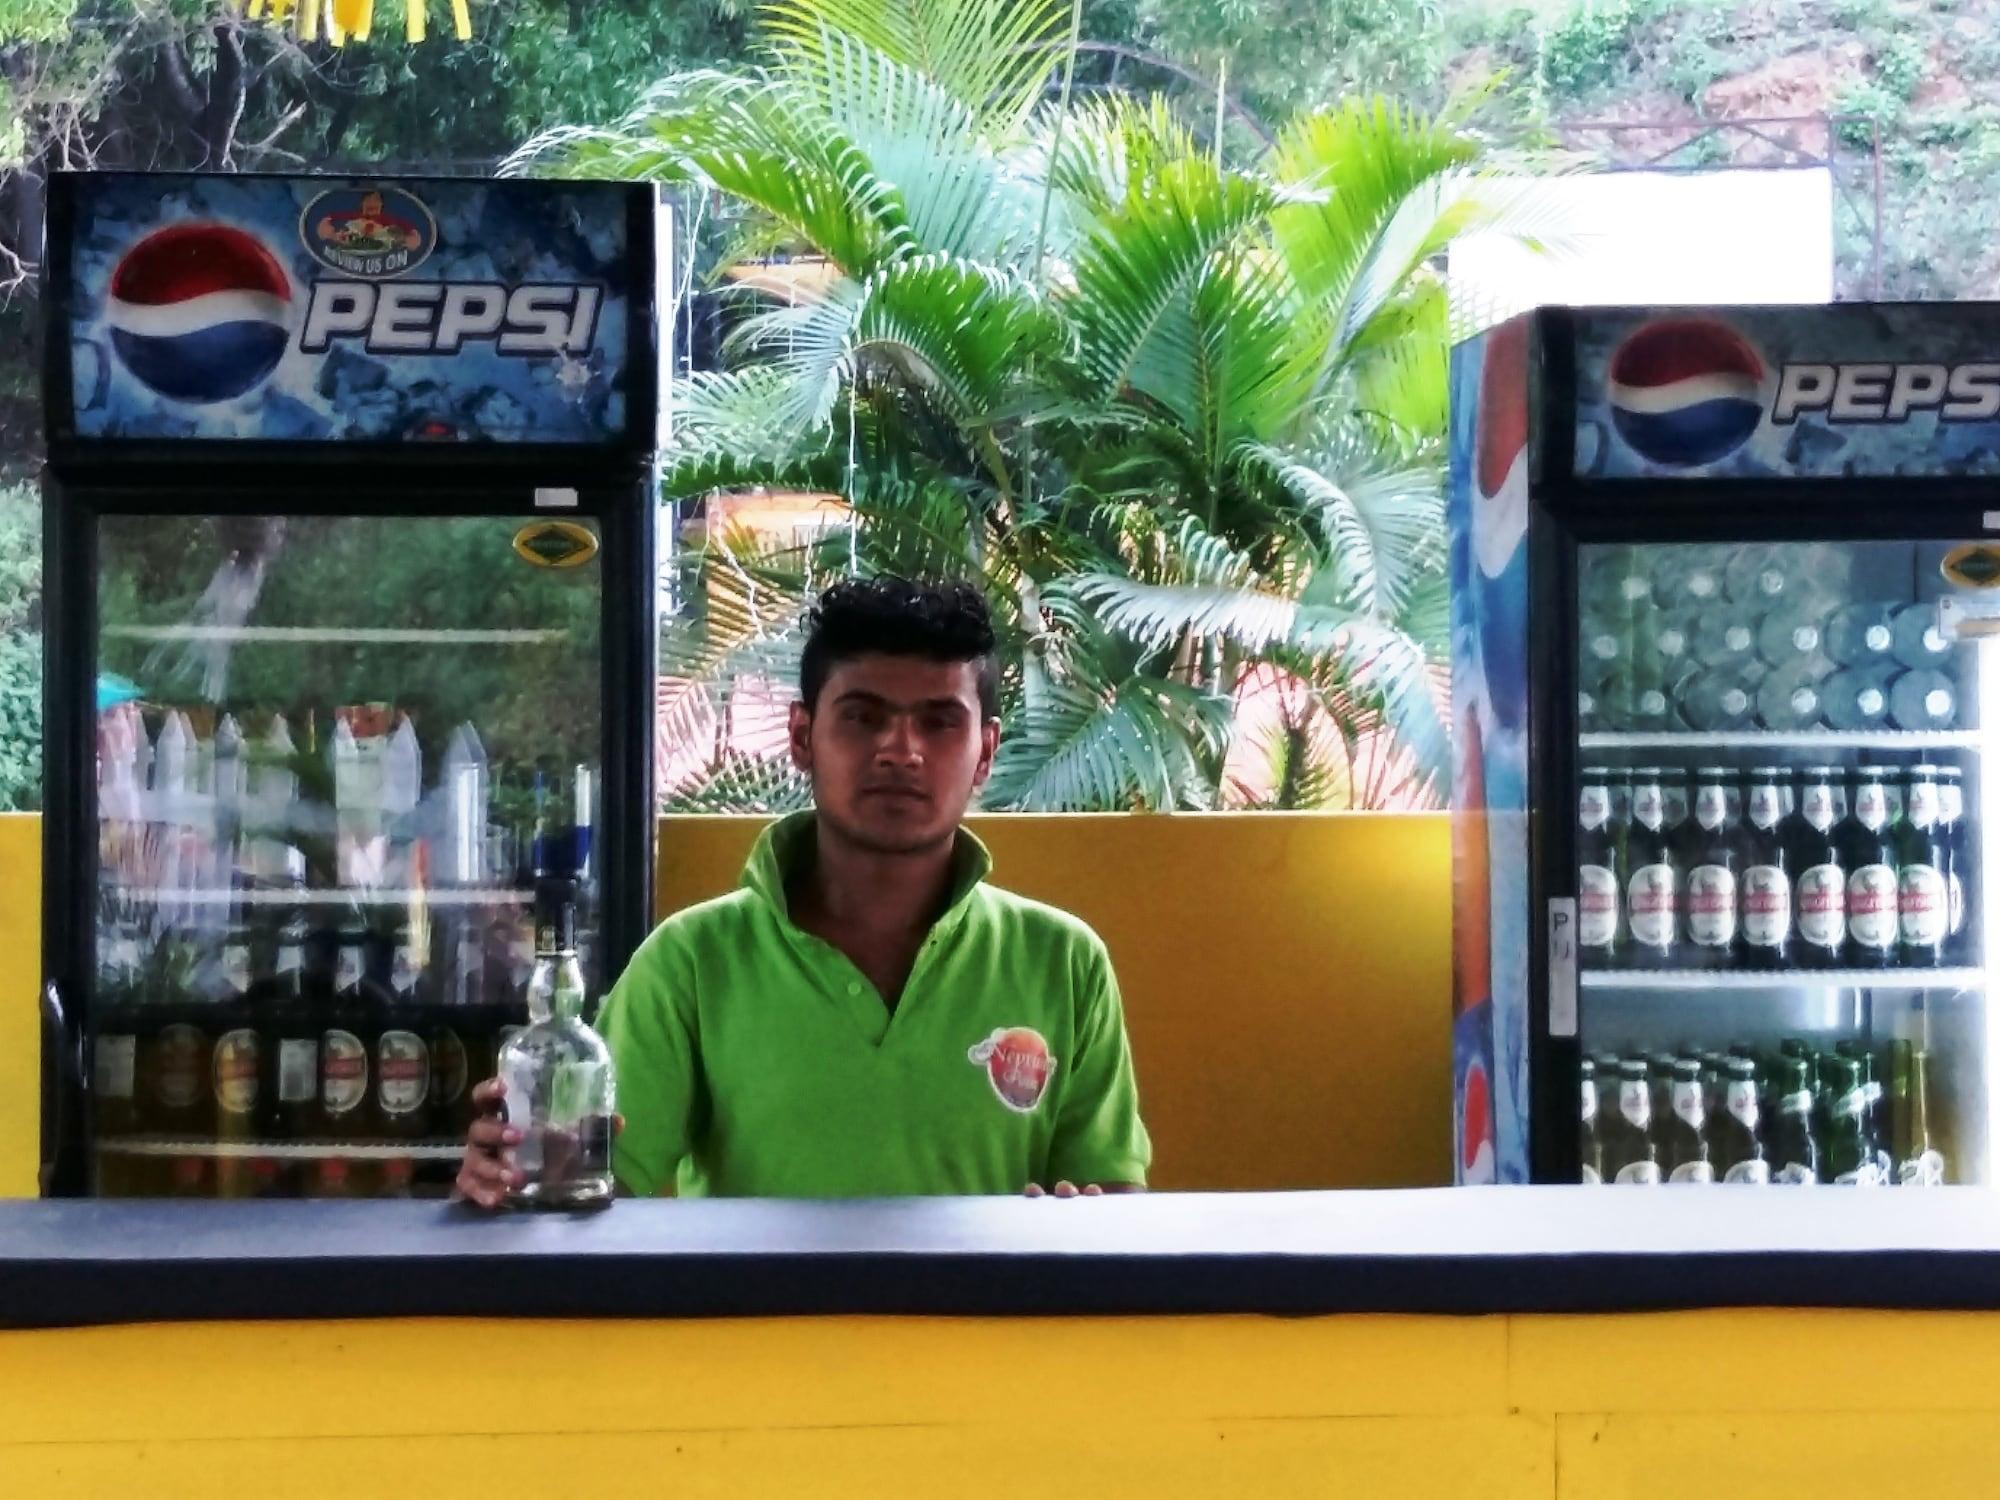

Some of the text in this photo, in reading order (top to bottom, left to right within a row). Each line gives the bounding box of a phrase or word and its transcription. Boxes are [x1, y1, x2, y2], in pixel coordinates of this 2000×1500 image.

[366, 258, 382, 274] US
[386, 249, 408, 270] ON
[301, 280, 602, 354] PEPSI
[1772, 363, 2000, 423] PEPS
